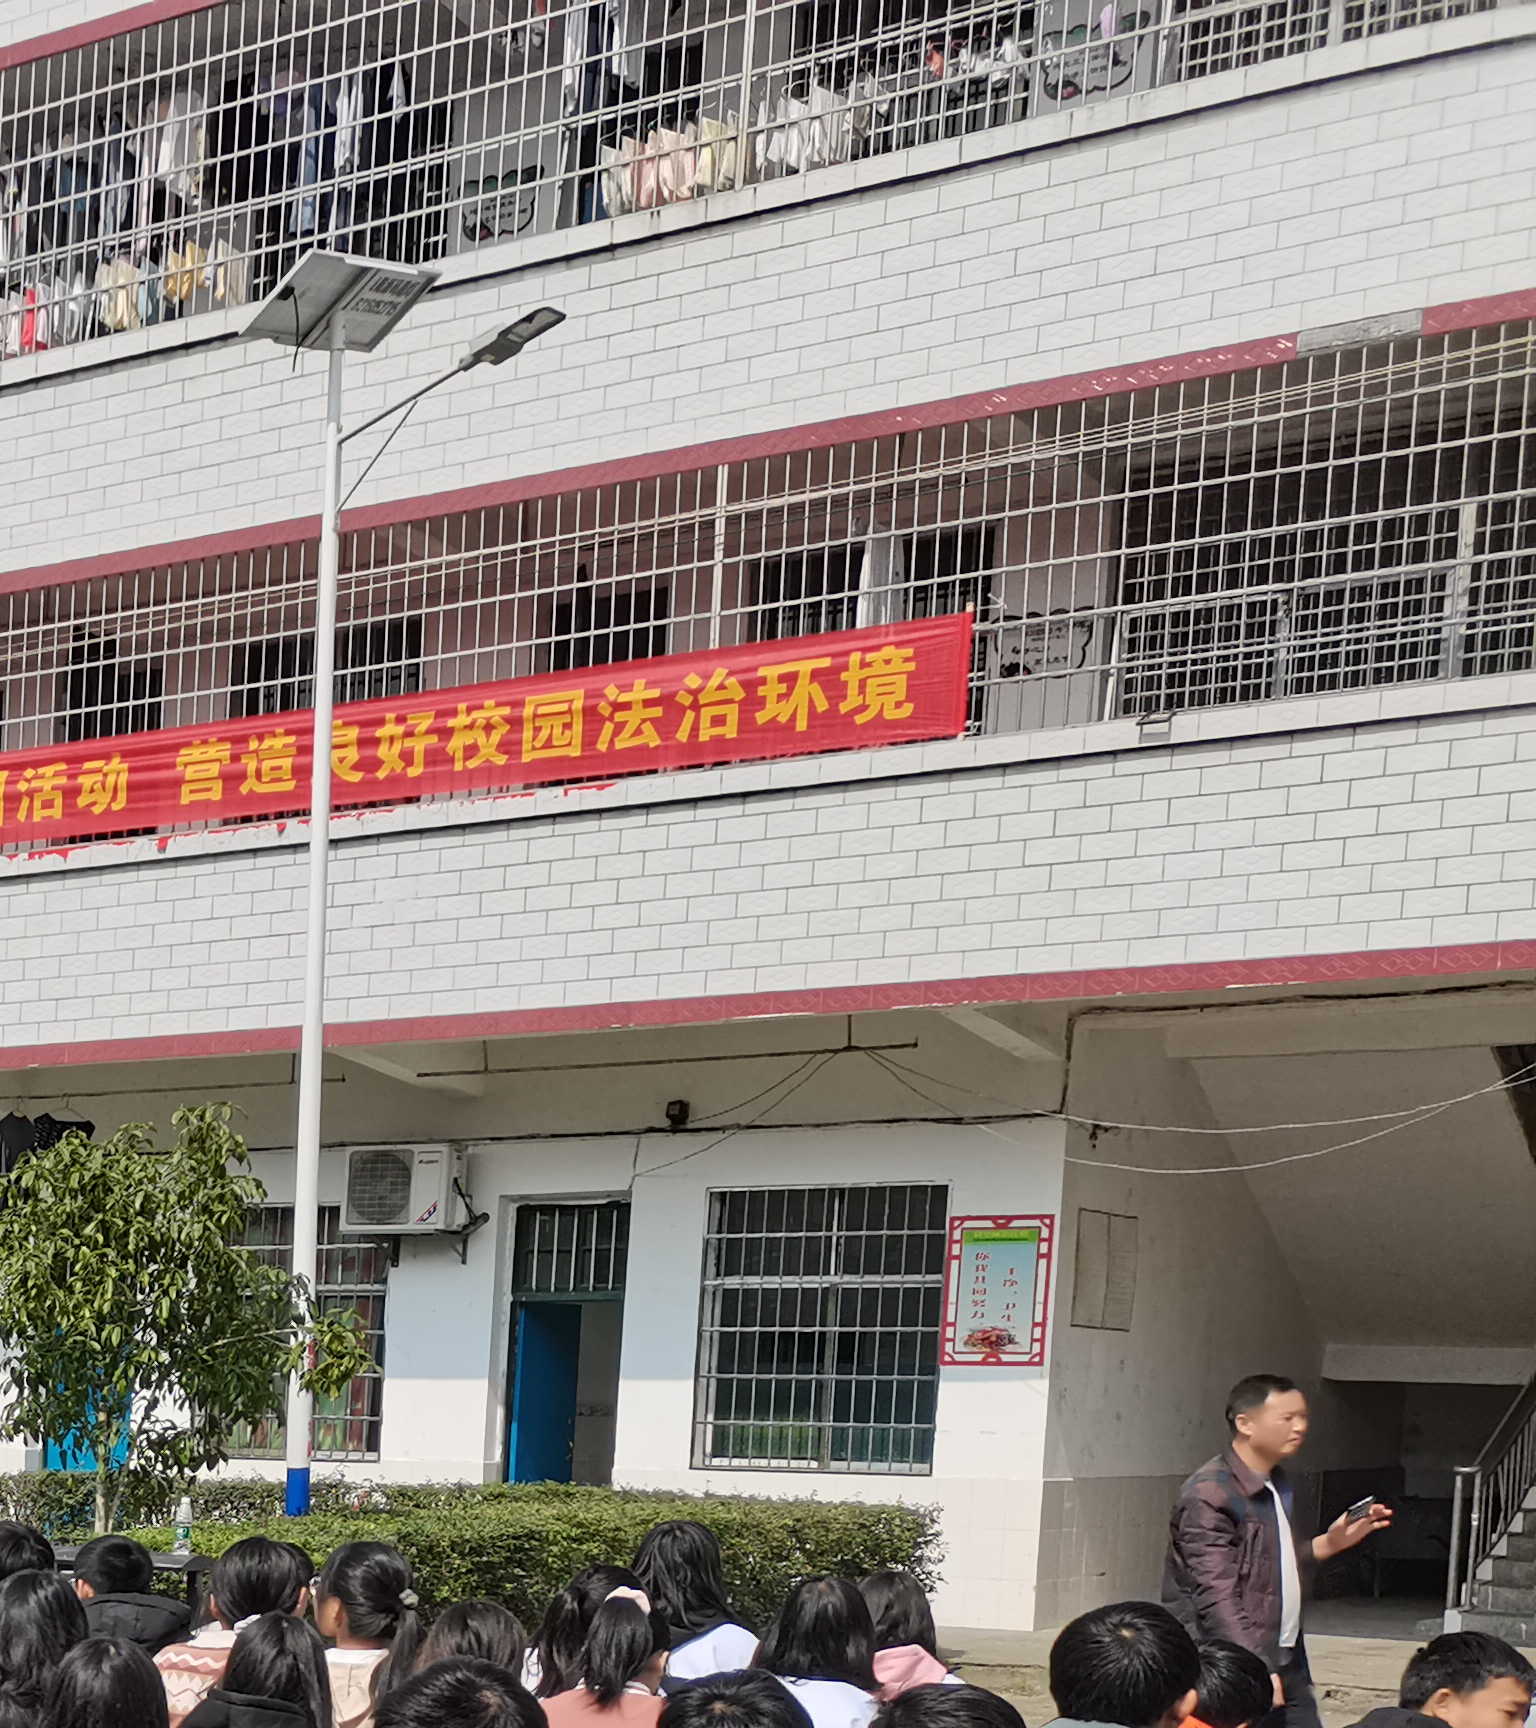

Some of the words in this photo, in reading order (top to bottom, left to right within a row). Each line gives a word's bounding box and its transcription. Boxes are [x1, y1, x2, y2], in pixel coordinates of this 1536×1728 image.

[175, 644, 918, 805] 营造良好校园法治环境
